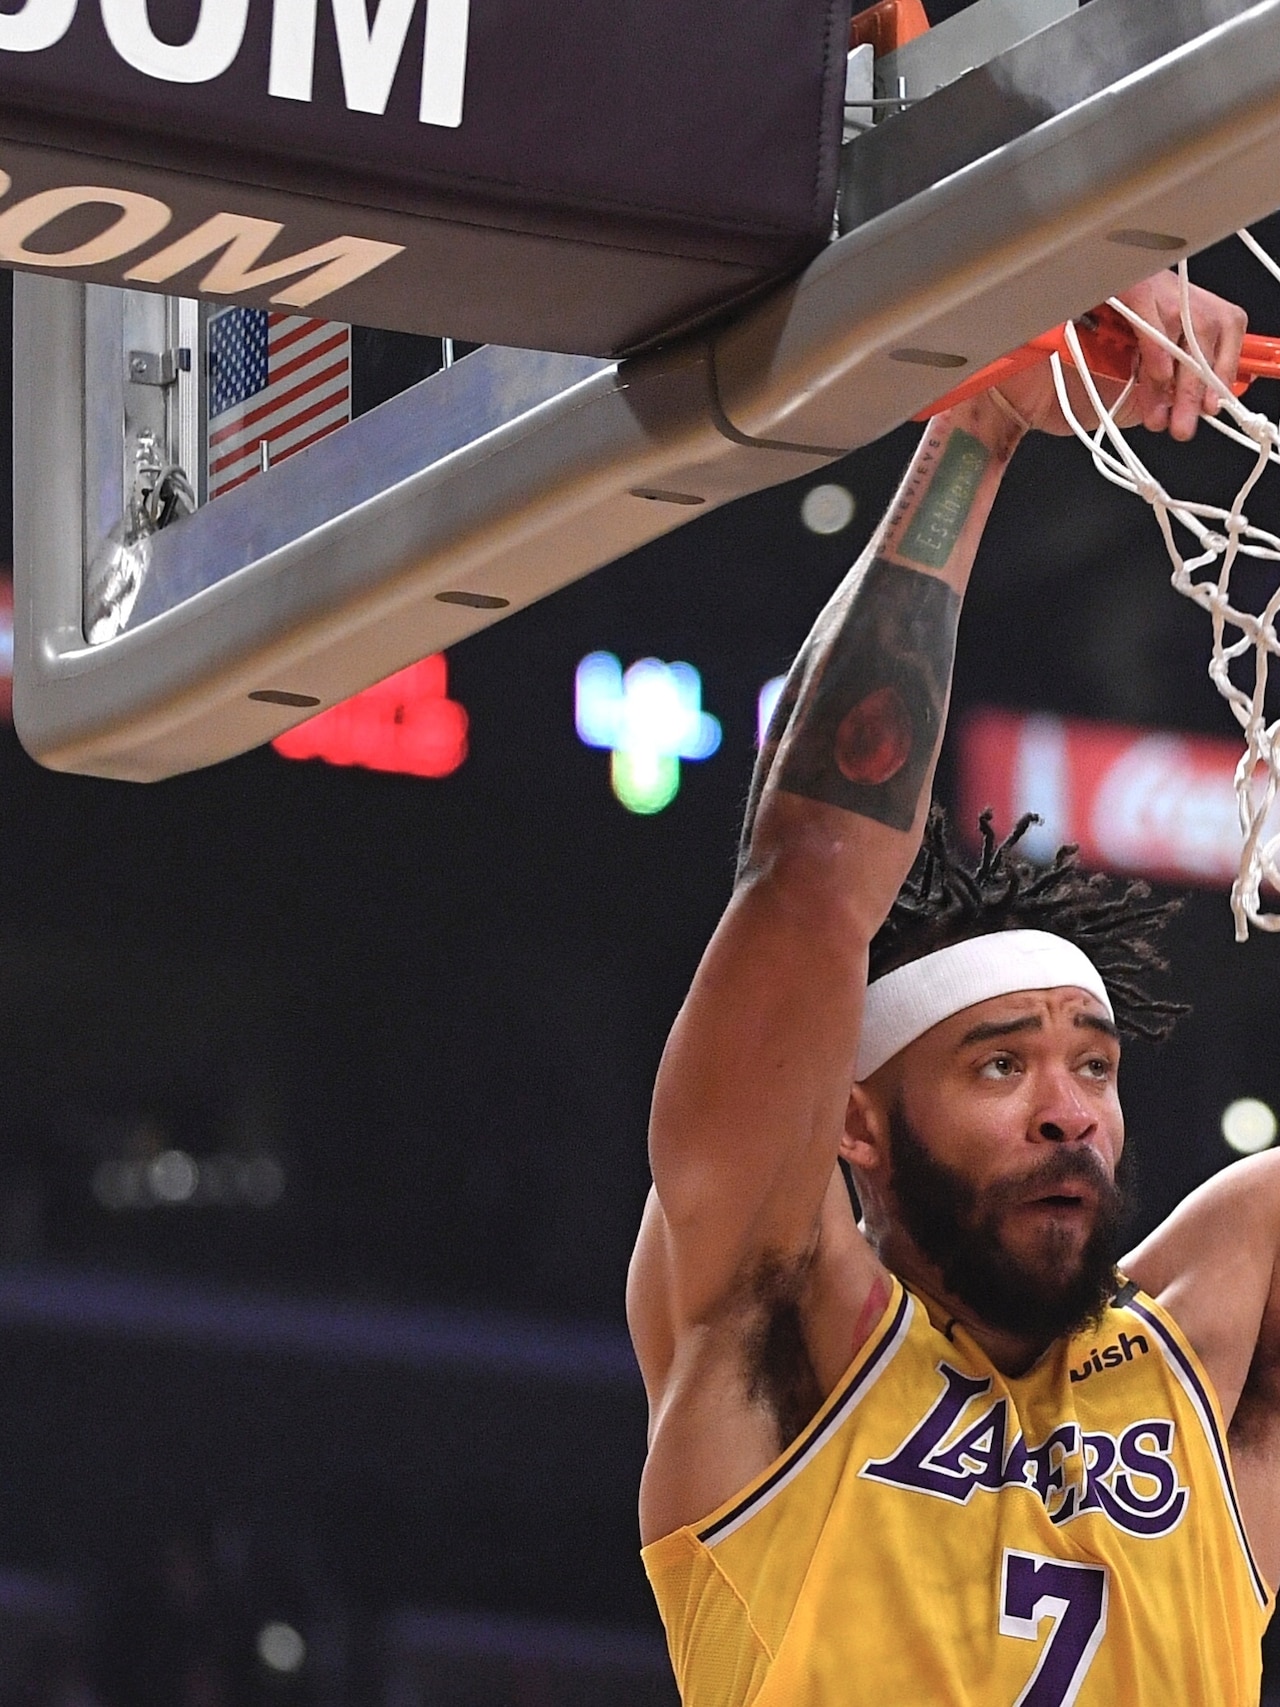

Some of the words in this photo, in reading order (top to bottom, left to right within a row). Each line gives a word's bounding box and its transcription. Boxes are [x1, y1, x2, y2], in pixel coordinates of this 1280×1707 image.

[0, 0, 470, 128] OM
[0, 168, 406, 309] OM
[999, 1547, 1111, 1707] 7
